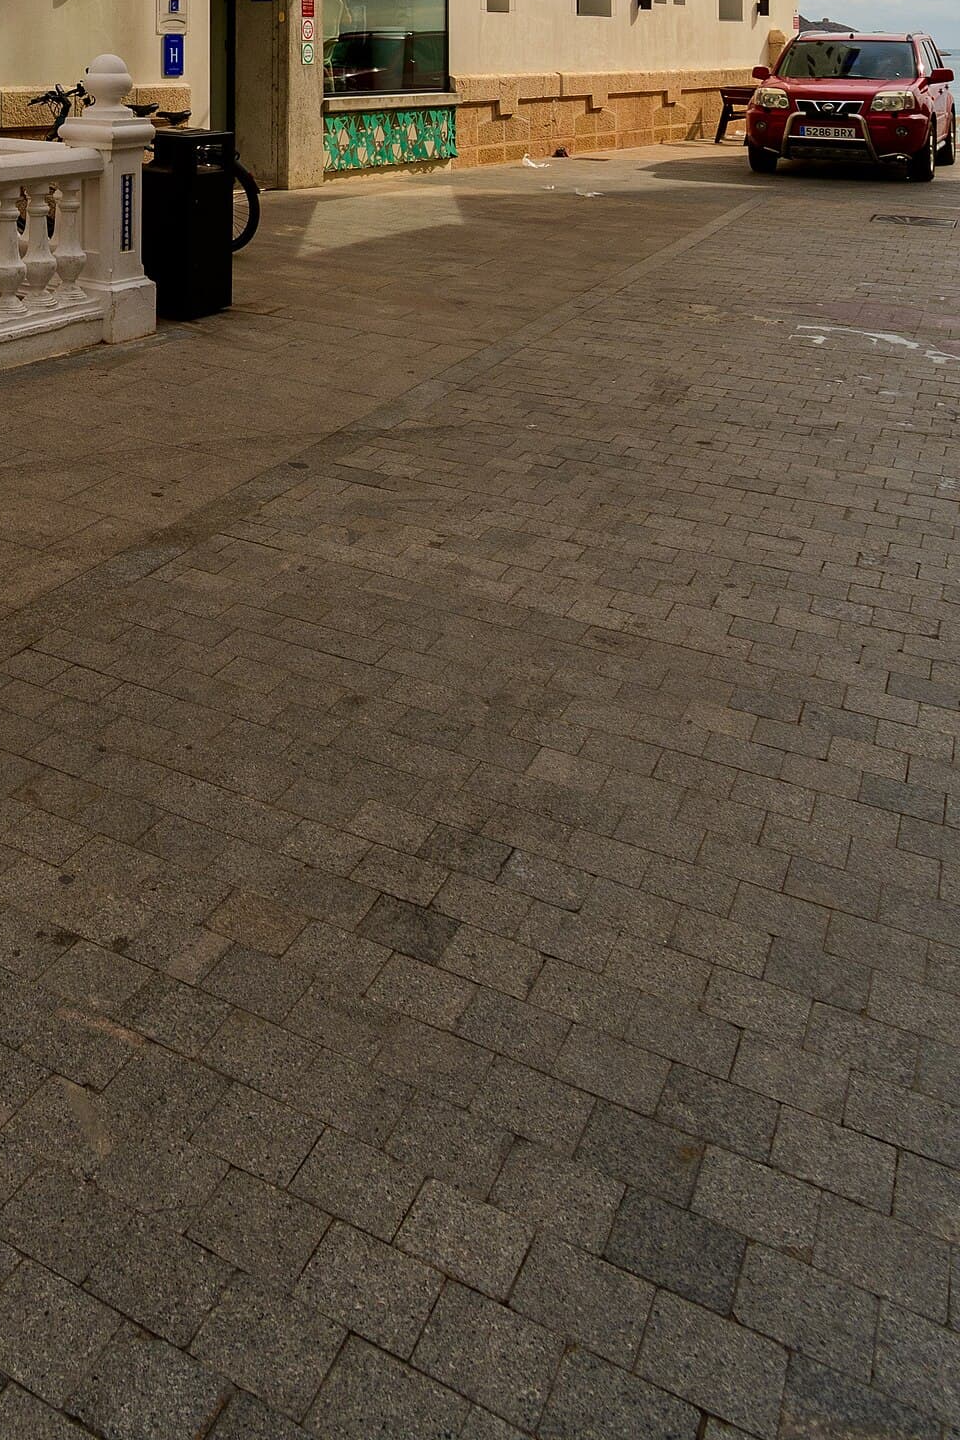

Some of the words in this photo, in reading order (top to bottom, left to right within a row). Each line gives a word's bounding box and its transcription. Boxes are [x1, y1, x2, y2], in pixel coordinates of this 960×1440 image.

[169, 47, 178, 64] H
[806, 127, 831, 137] 5286
[833, 128, 853, 138] BRX
